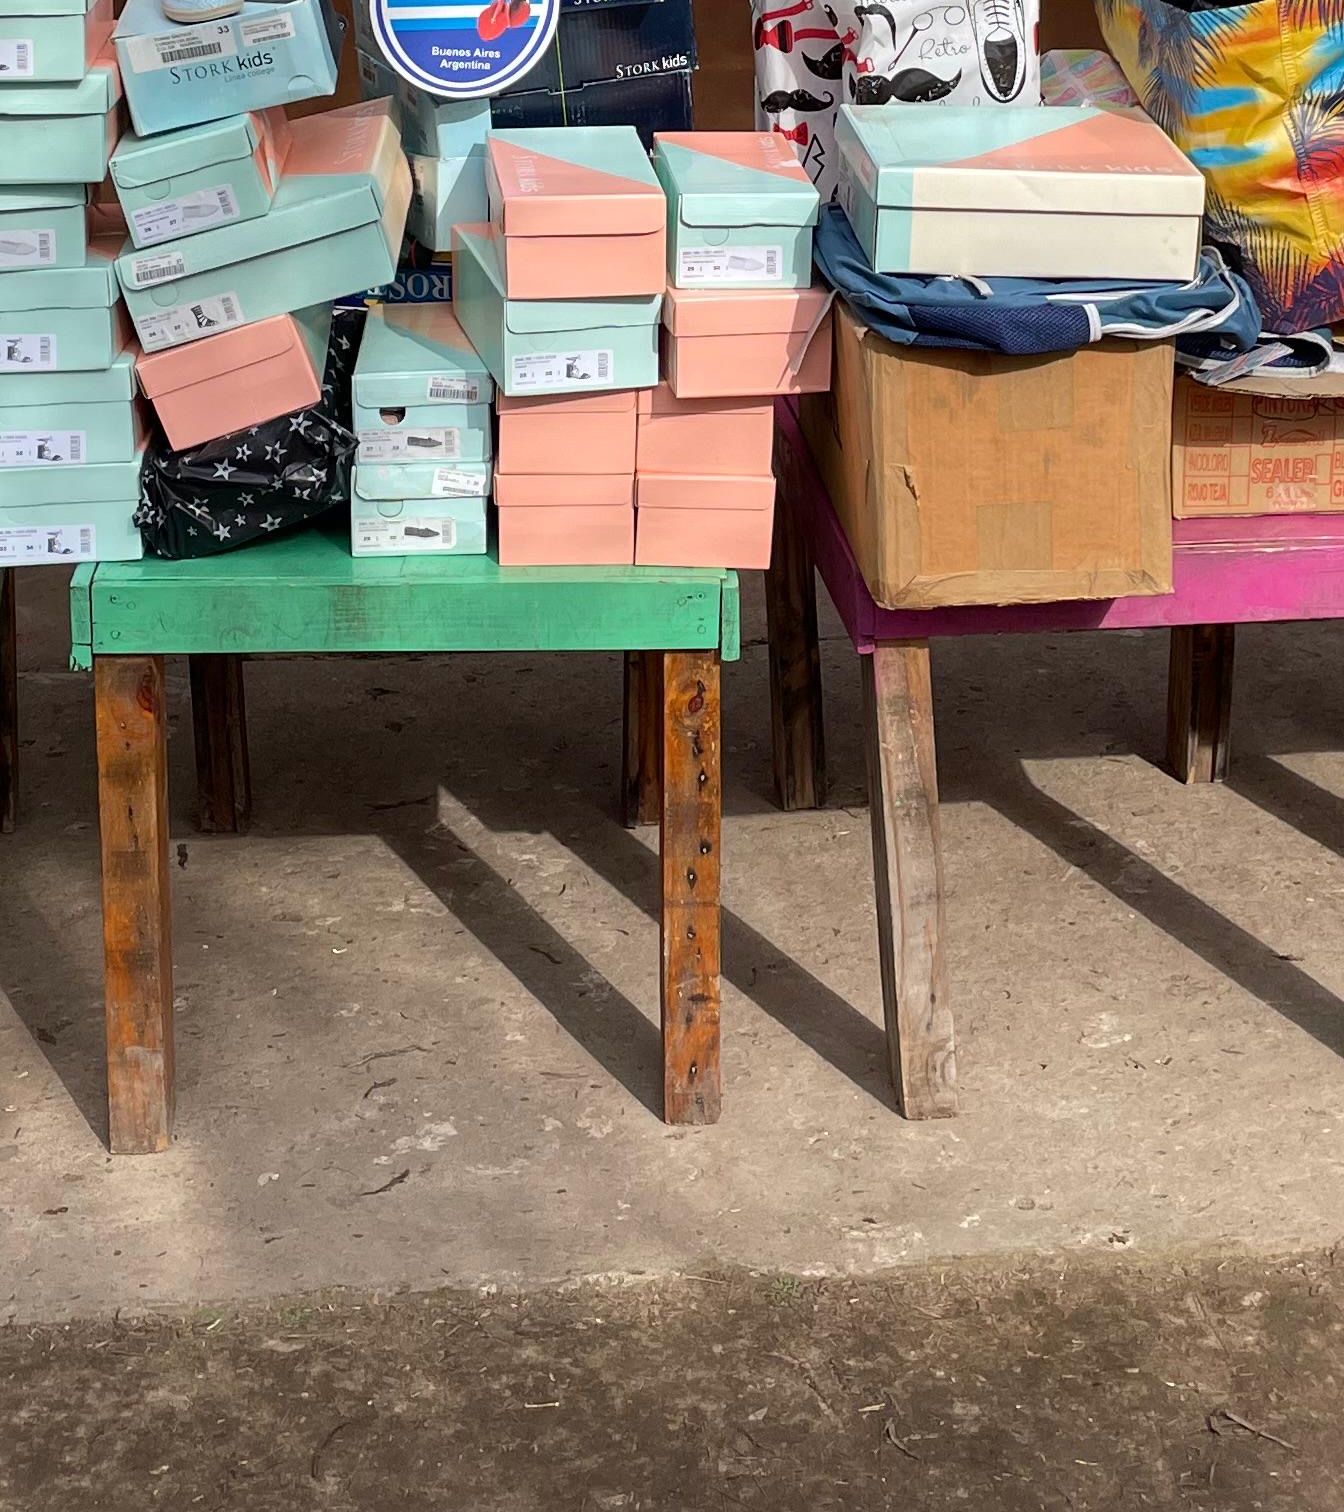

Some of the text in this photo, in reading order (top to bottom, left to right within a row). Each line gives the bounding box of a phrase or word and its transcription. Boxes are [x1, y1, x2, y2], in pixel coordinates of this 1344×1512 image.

[217, 25, 230, 34] 33
[432, 46, 500, 58] Buenos Aires
[170, 50, 274, 85] STORK kids
[440, 59, 490, 70] Argentina
[616, 53, 688, 78] STORK kids
[1251, 457, 1315, 484] SEALER
